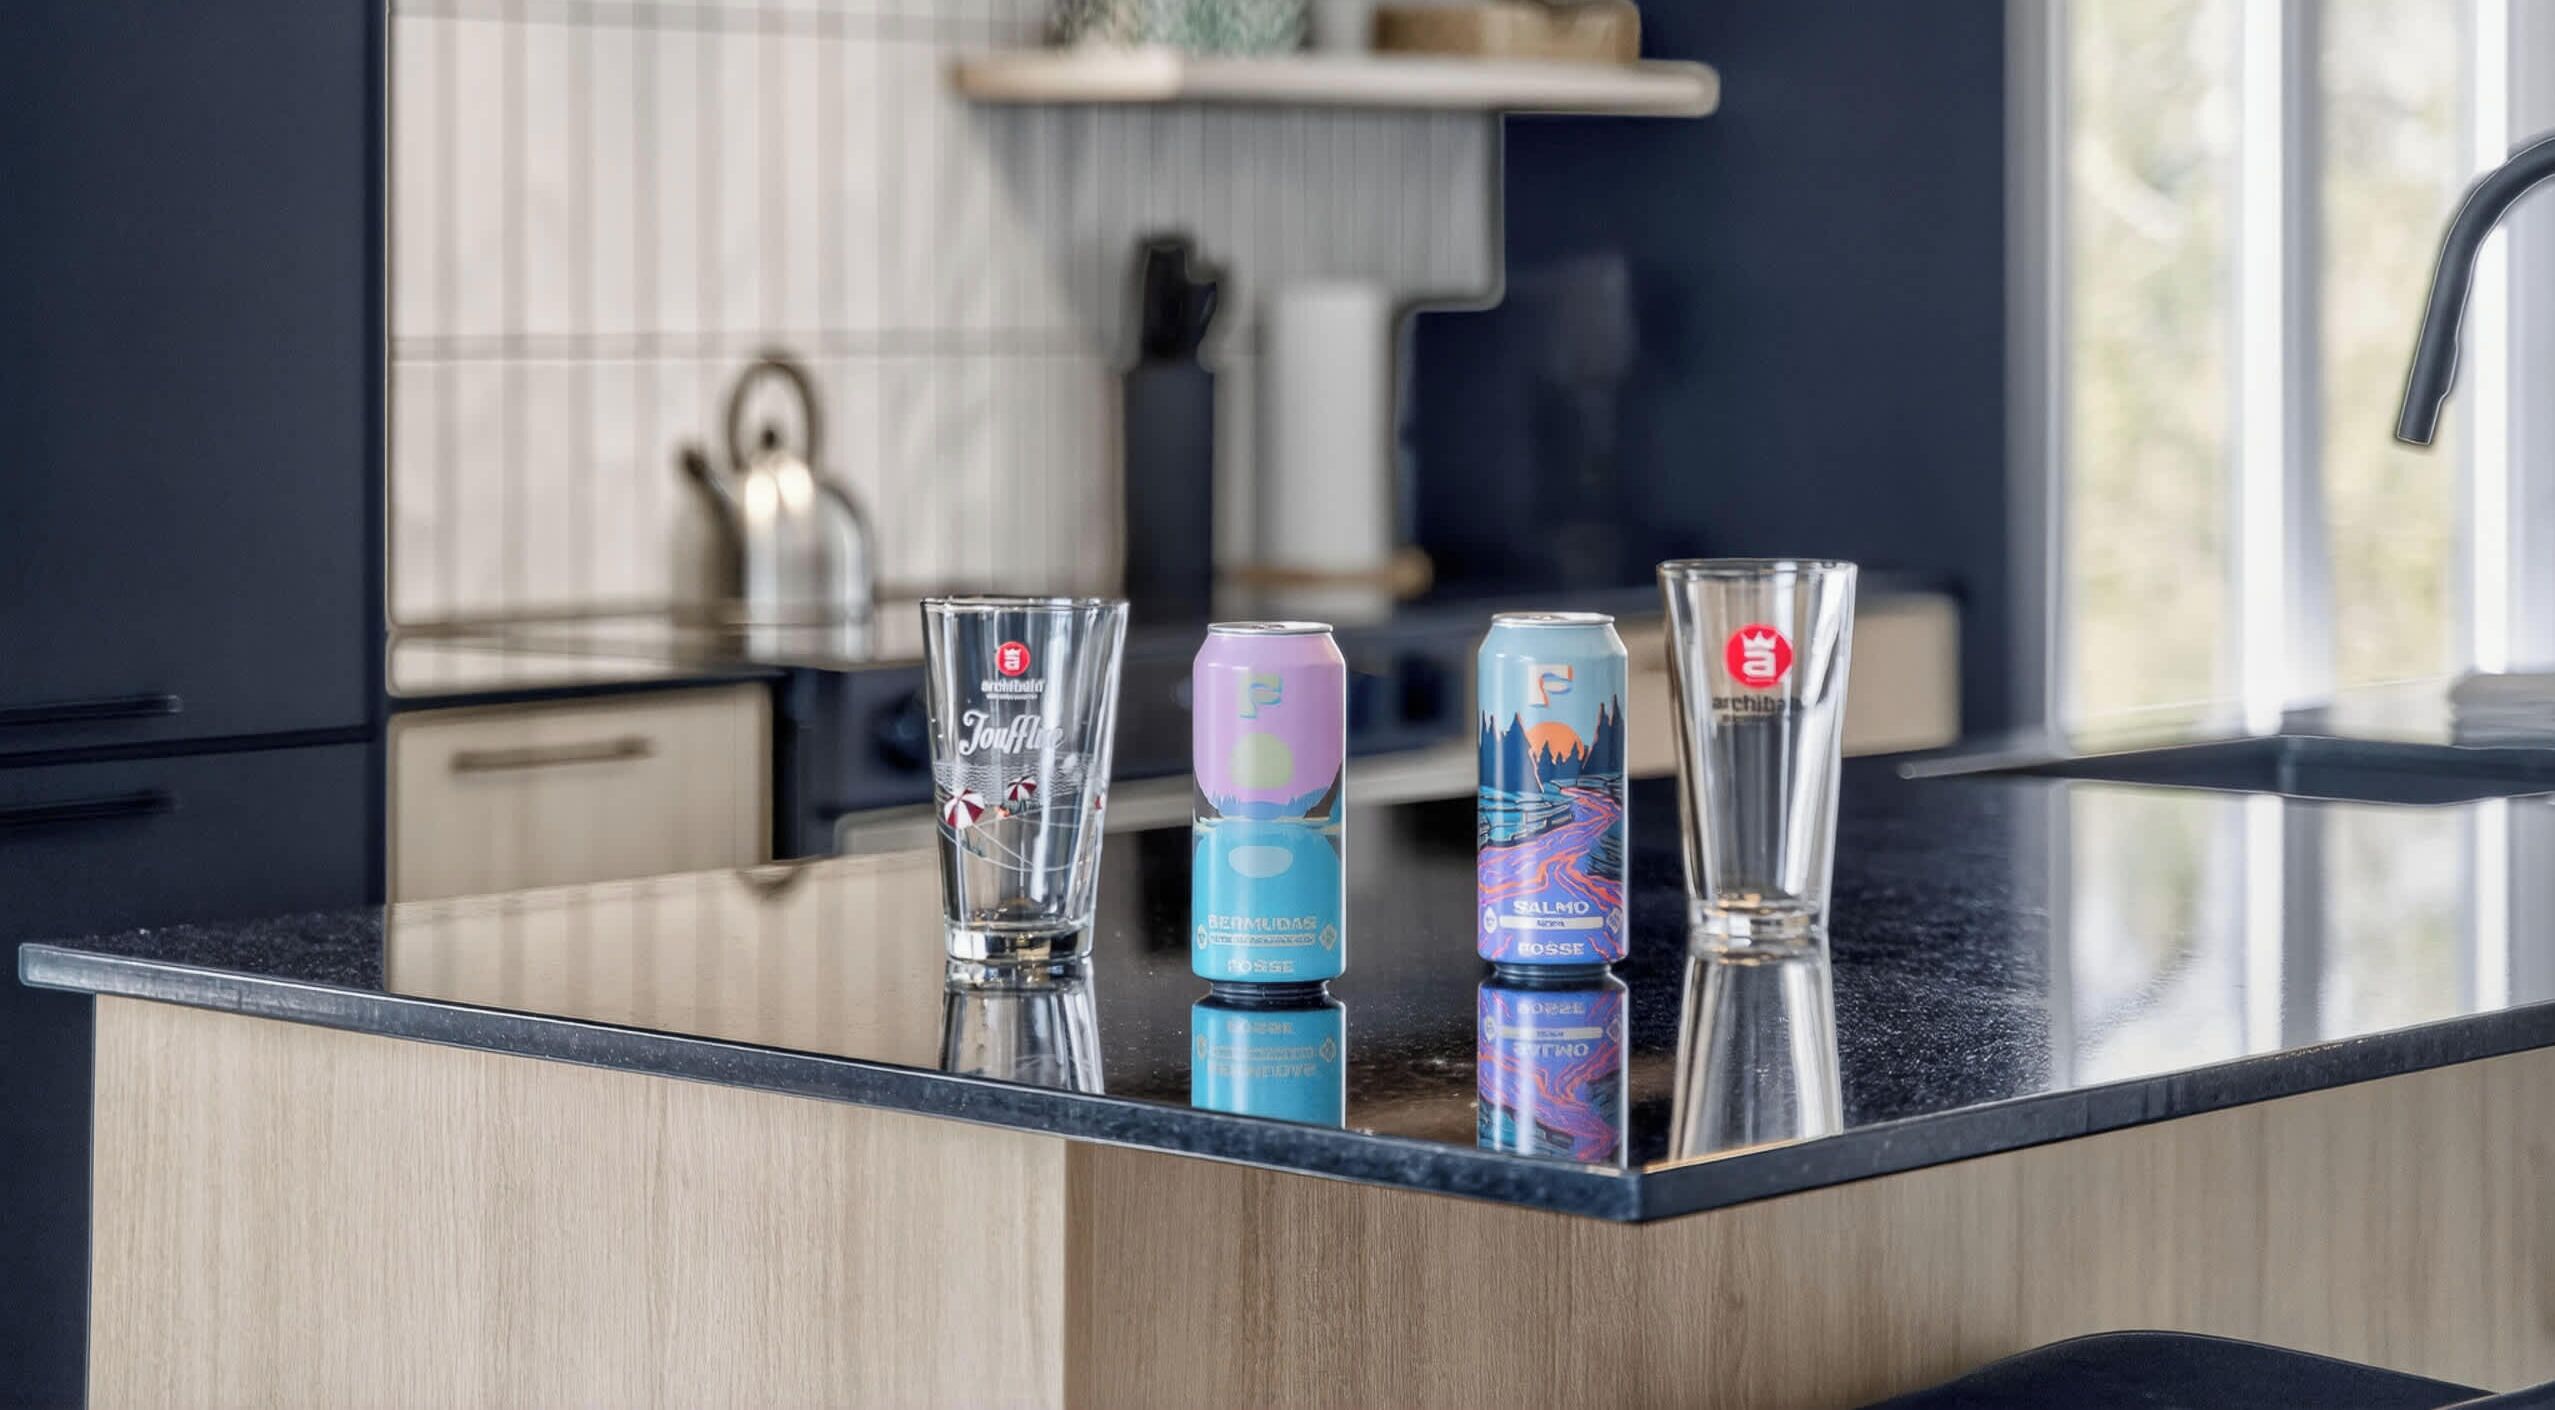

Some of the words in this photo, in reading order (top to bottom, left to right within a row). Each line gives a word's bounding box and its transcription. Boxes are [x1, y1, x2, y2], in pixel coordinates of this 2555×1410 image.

[1527, 664, 1574, 708] F
[1711, 694, 1805, 713] archiba
[1513, 900, 1590, 915] SALMO
[1207, 914, 1317, 931] BERMUDAS
